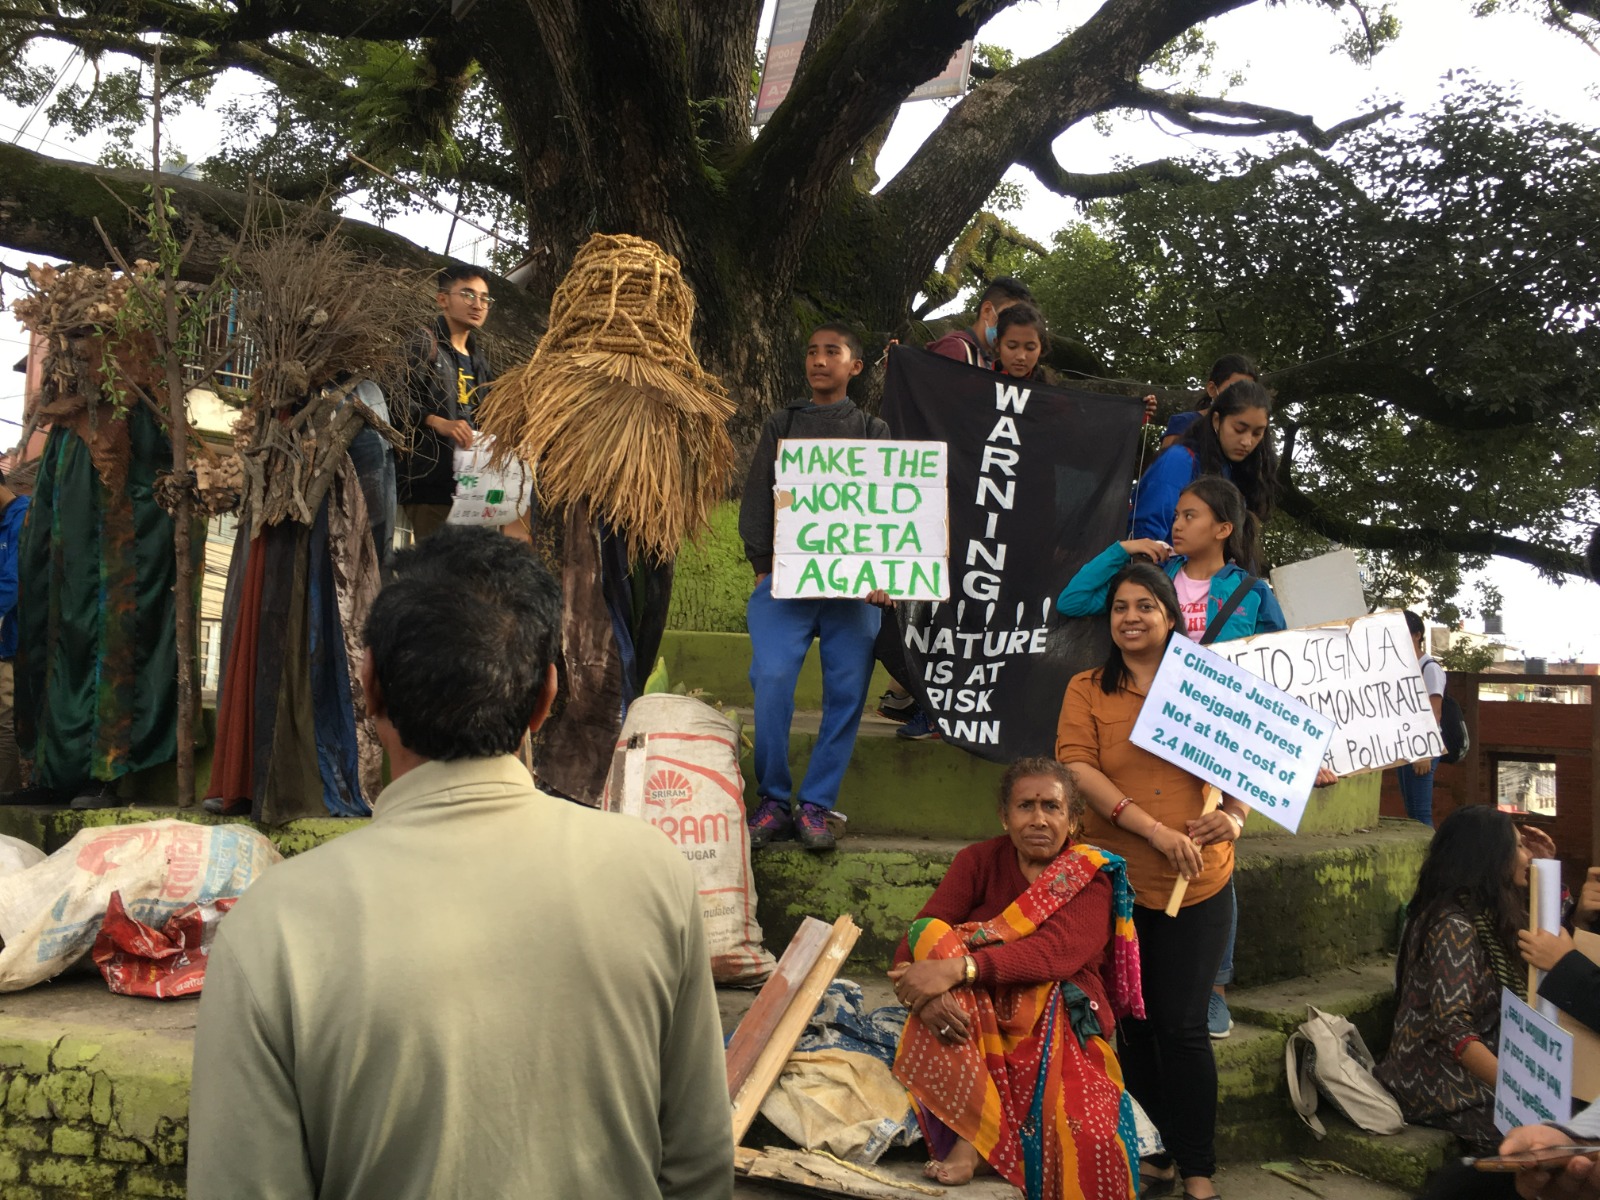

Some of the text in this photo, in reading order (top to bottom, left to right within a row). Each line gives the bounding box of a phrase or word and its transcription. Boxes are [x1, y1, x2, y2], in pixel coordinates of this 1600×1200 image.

[781, 445, 939, 477] MAKE THE
[791, 482, 922, 516] WORLD
[962, 382, 1031, 601] WARNING
[796, 521, 922, 555] GRETA
[795, 558, 941, 597] AGAIN
[905, 624, 1049, 659] NATURE
[924, 661, 1006, 685] IS AT
[1255, 647, 1294, 693] TO
[926, 687, 994, 713] RISK
[1245, 687, 1300, 726] Justice
[1302, 718, 1324, 740] for
[1179, 679, 1303, 759] Neejgadh Forest
[1151, 727, 1178, 751] 2.4
[1180, 741, 1232, 781] Million
[1161, 701, 1296, 786] Not at the cost of
[1346, 722, 1442, 771] Pollution
[652, 790, 686, 799] SRIRAM
[682, 849, 717, 860] UGAR
